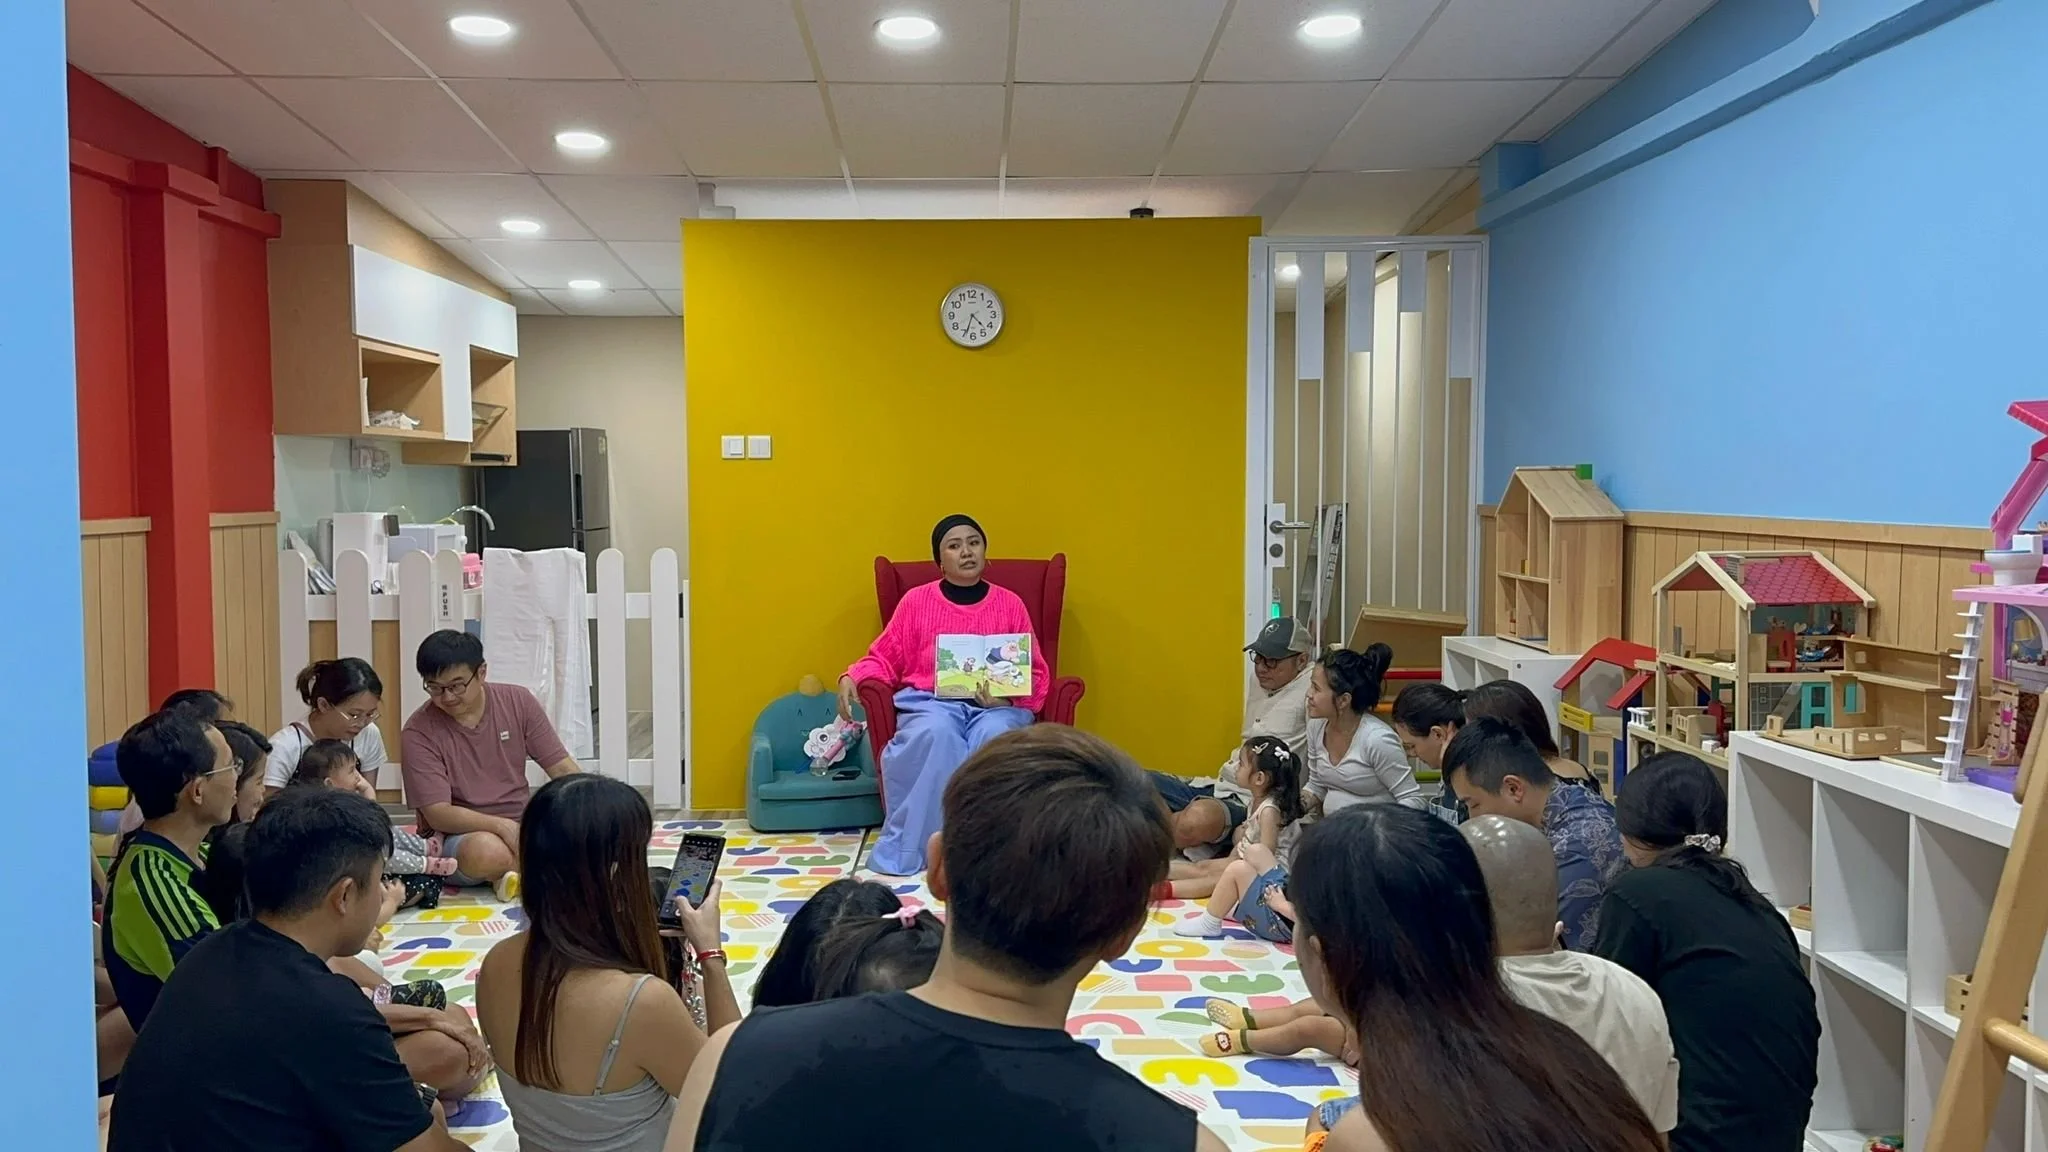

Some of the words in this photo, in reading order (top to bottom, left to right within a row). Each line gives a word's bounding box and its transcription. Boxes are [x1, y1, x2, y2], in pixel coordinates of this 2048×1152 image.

[958, 293, 966, 301] 11
[967, 289, 977, 299] 12
[980, 292, 985, 301] 1
[951, 301, 961, 309] 10
[986, 300, 993, 309] 2
[948, 311, 955, 320] 9
[990, 310, 997, 319] 3
[952, 322, 959, 331] 8
[986, 321, 993, 330] 4
[960, 328, 967, 338] 7
[969, 332, 977, 341] 6
[980, 328, 987, 337] 5
